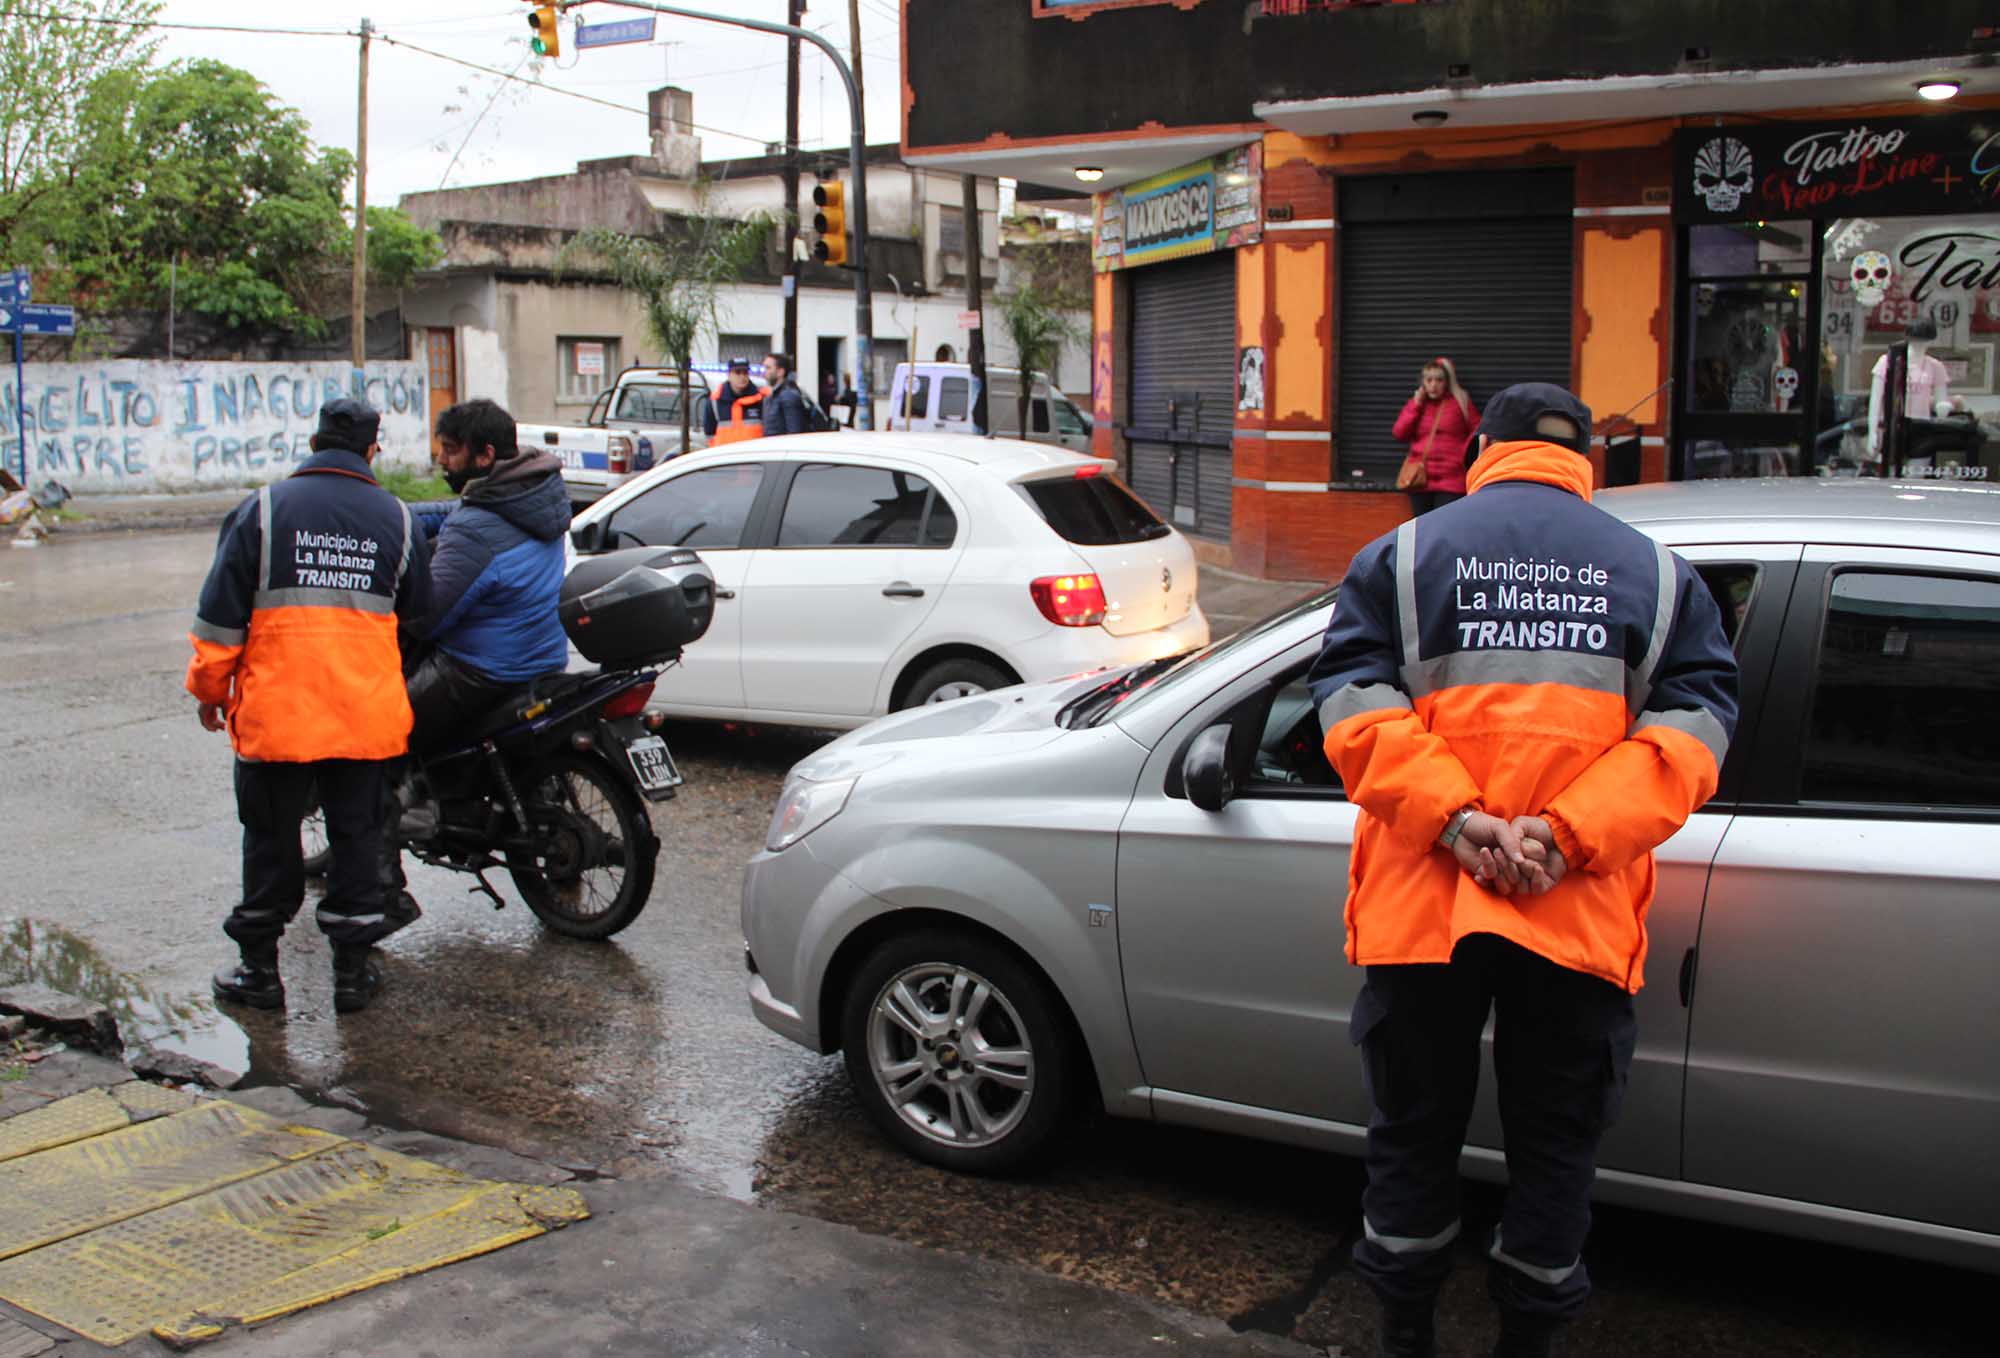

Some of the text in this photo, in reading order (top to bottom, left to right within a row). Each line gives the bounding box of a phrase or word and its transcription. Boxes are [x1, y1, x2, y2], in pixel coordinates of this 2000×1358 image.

[1784, 125, 1911, 186] Tattoo
[1843, 146, 1941, 197] Line
[295, 530, 378, 554] Municipio de
[295, 548, 376, 571] La Matanza
[1456, 556, 1608, 588] Municipio de
[296, 569, 372, 590] TRANSITO
[1456, 584, 1608, 614] La Matanza
[1457, 620, 1608, 650] TRANSITO
[638, 748, 662, 767] 339
